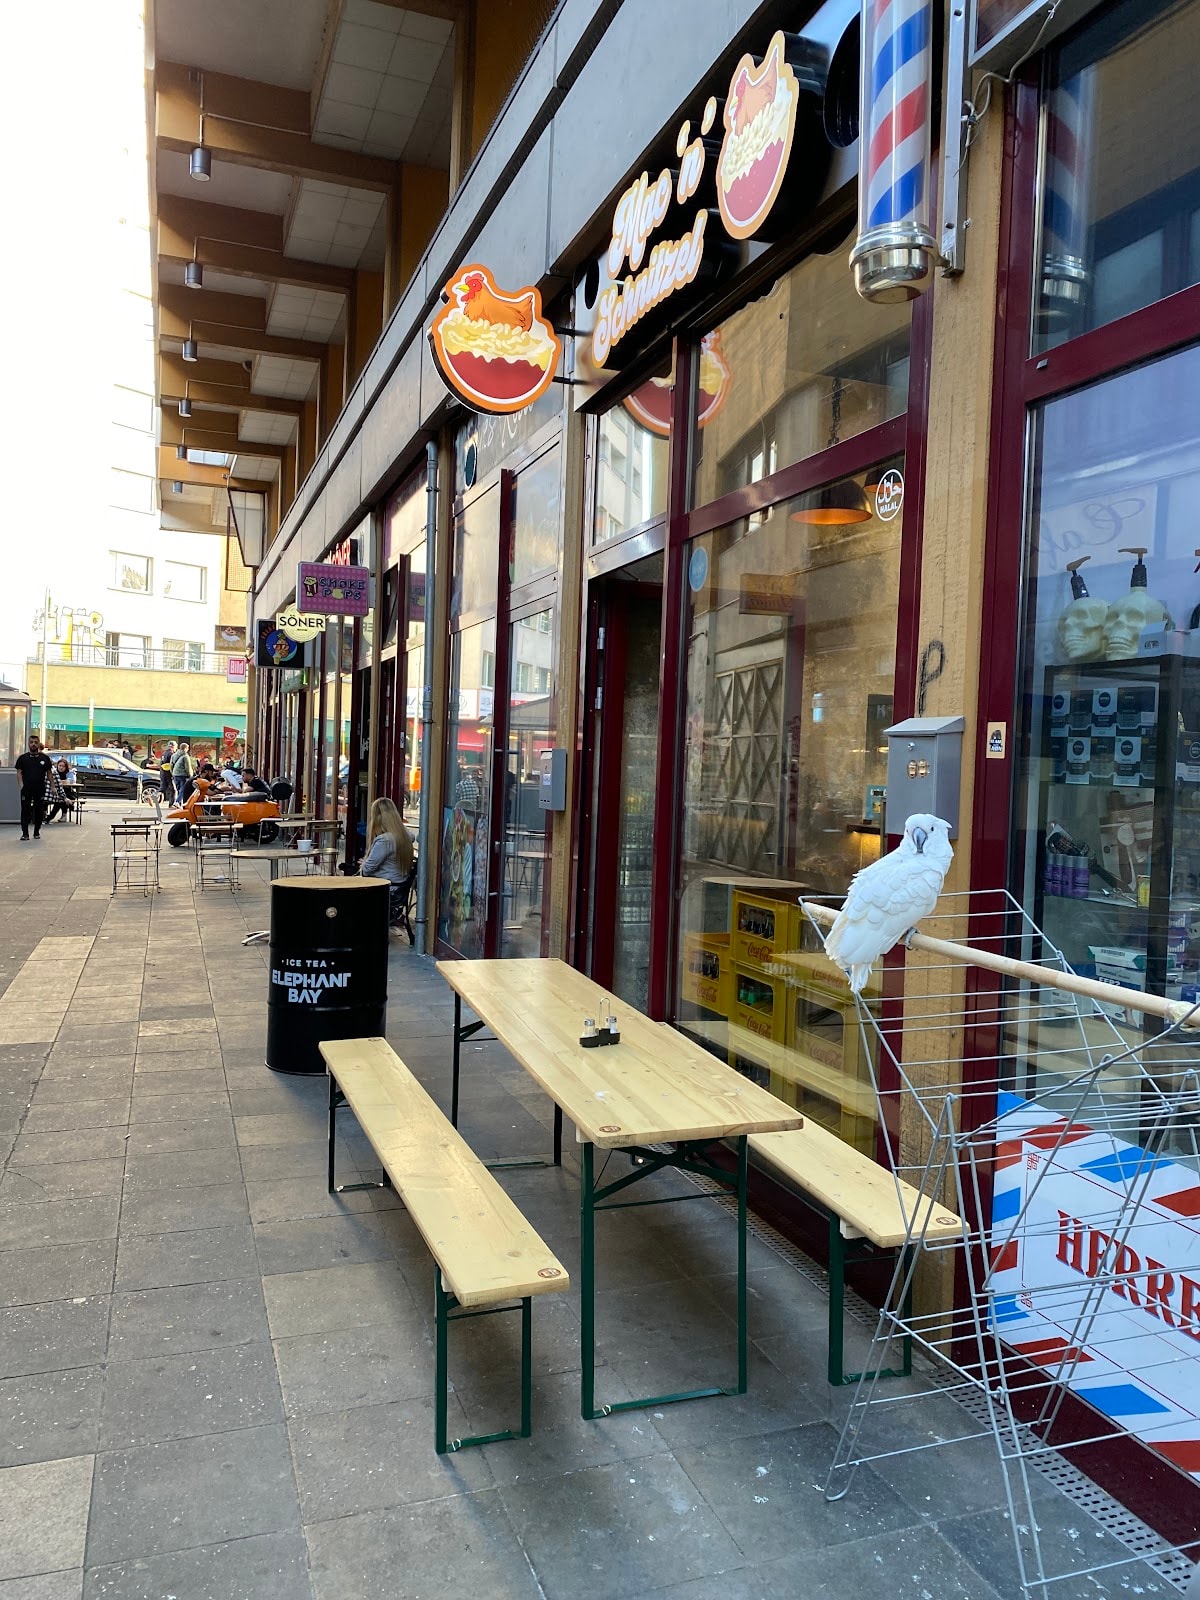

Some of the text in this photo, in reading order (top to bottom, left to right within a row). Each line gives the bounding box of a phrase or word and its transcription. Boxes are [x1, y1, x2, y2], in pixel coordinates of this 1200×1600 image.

[607, 171, 672, 280] Mac
[592, 209, 708, 368] Schnitzel
[880, 501, 898, 514] HALAL
[319, 577, 365, 590] SMOKE
[279, 614, 324, 628] SÖNER
[286, 959, 302, 967] ICE
[271, 969, 352, 988] ELEPHANT
[288, 988, 323, 1003] BAY
